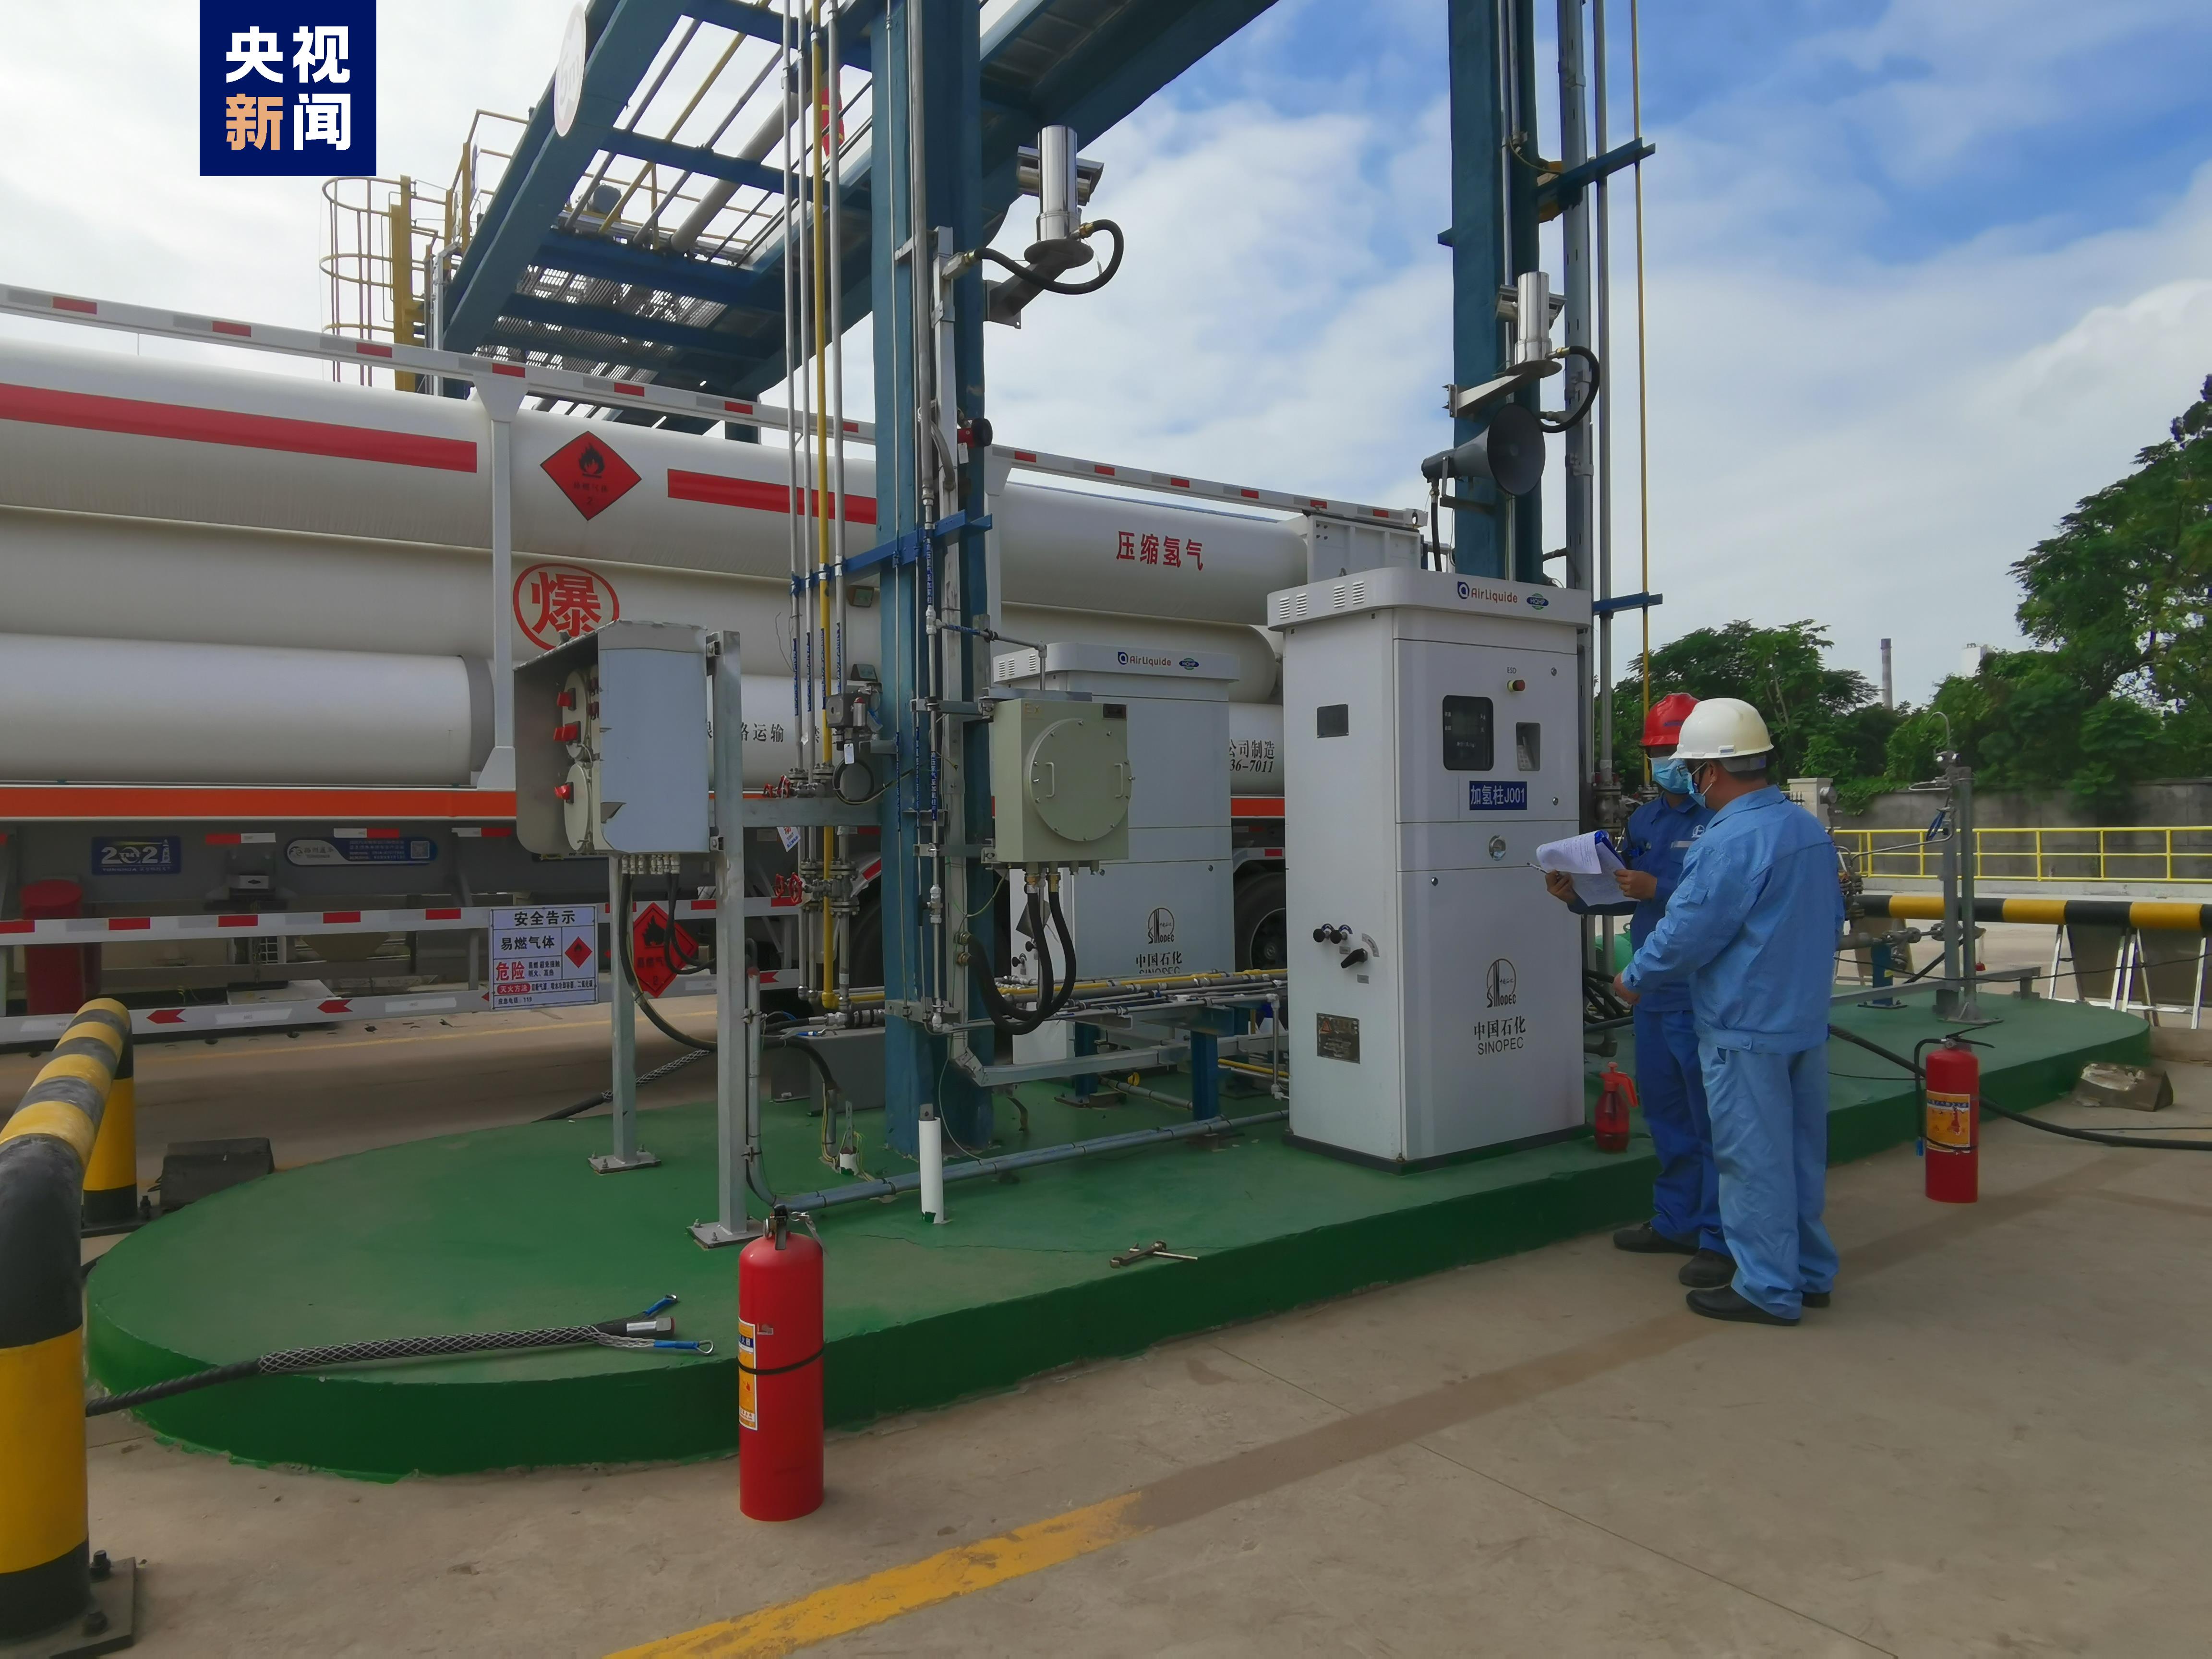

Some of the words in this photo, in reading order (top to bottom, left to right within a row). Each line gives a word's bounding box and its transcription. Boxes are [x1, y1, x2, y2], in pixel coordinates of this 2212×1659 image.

[1116, 531, 1203, 571] 压缩氢气
[531, 571, 602, 637] 爆
[1025, 703, 1040, 714] Ex
[1470, 785, 1525, 805] 加氢柱J001
[514, 910, 575, 926] 安全告示
[501, 935, 555, 950] 易燃气体
[1136, 951, 1182, 968] 中国石化
[496, 961, 525, 981] 危险
[1474, 1015, 1526, 1041] 中国石化
[1478, 1036, 1524, 1055] SINOPEC
